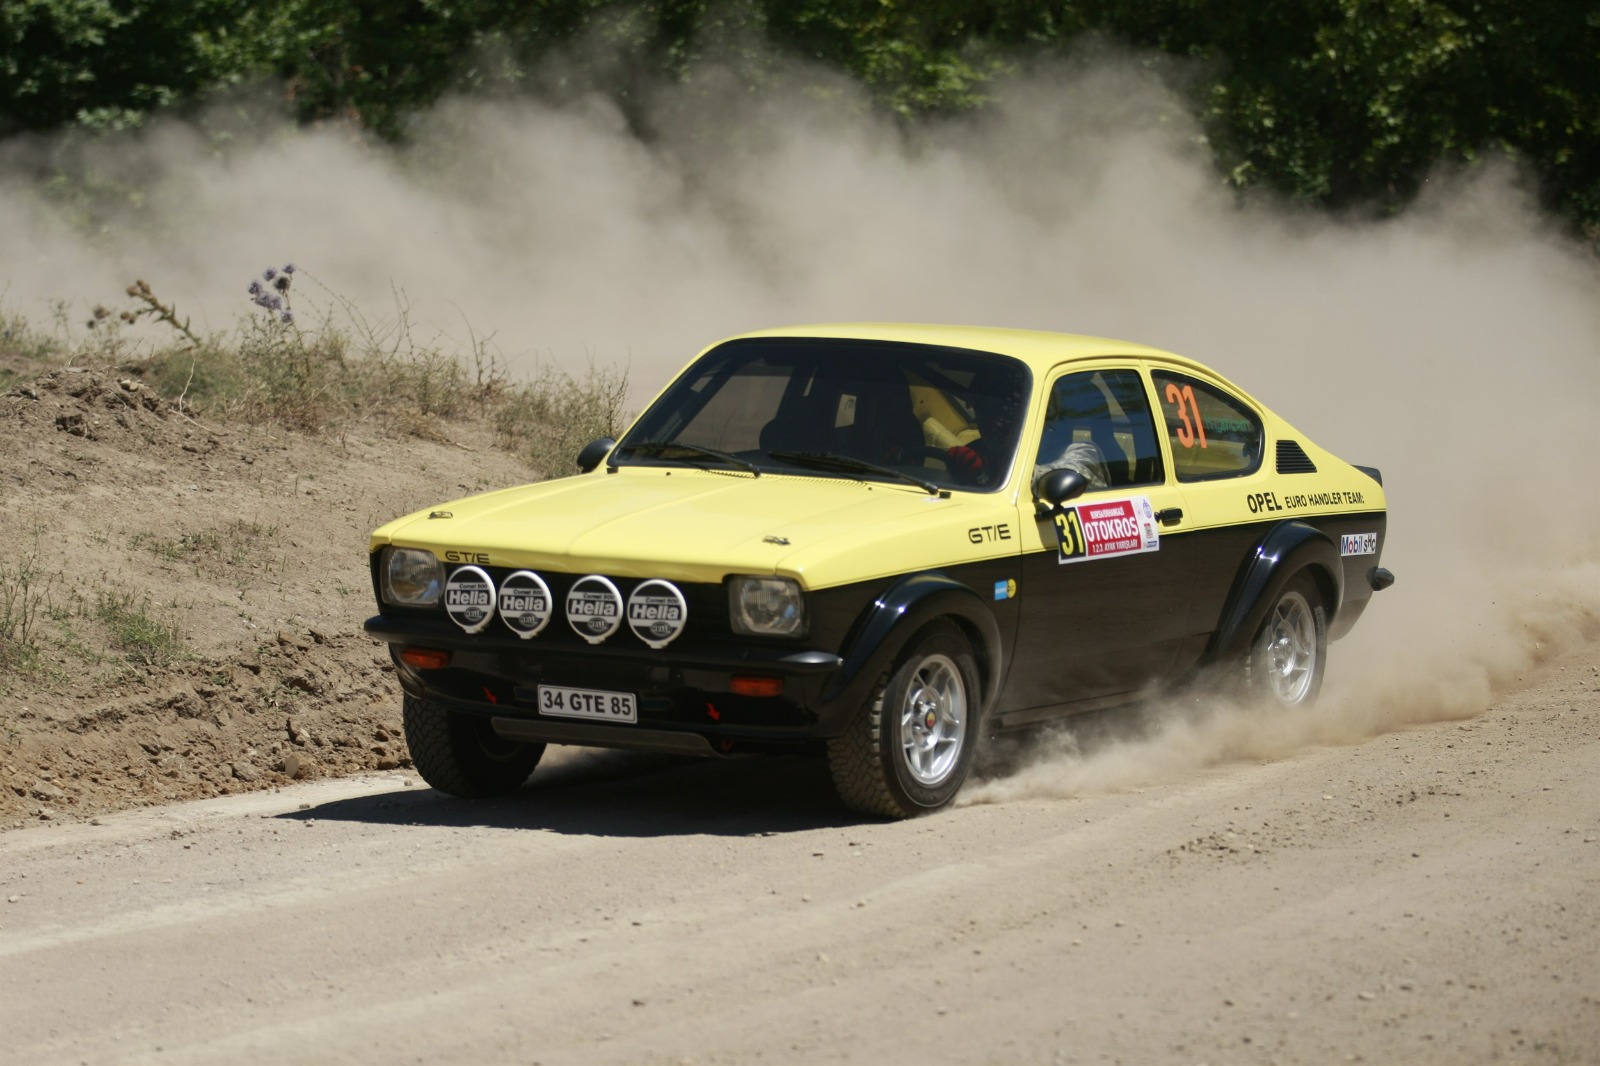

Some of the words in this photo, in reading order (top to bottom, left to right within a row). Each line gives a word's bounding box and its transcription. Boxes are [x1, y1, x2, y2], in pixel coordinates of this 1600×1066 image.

[1165, 383, 1207, 449] 31
[1247, 491, 1282, 514] OPEL
[1285, 496, 1308, 508] EURO
[1308, 493, 1342, 506] HANDLER
[968, 523, 1011, 544] GT/E
[1055, 511, 1085, 556] 31
[1085, 517, 1138, 542] OTOKROS
[1341, 534, 1363, 555] Mobil
[444, 550, 491, 564] GT/E
[449, 590, 488, 605] Hella
[502, 596, 544, 611] Hella
[571, 599, 615, 616] Hella
[632, 604, 680, 620] Hella
[543, 690, 564, 710] 34
[569, 693, 606, 713] GTE
[611, 697, 631, 716] 85
